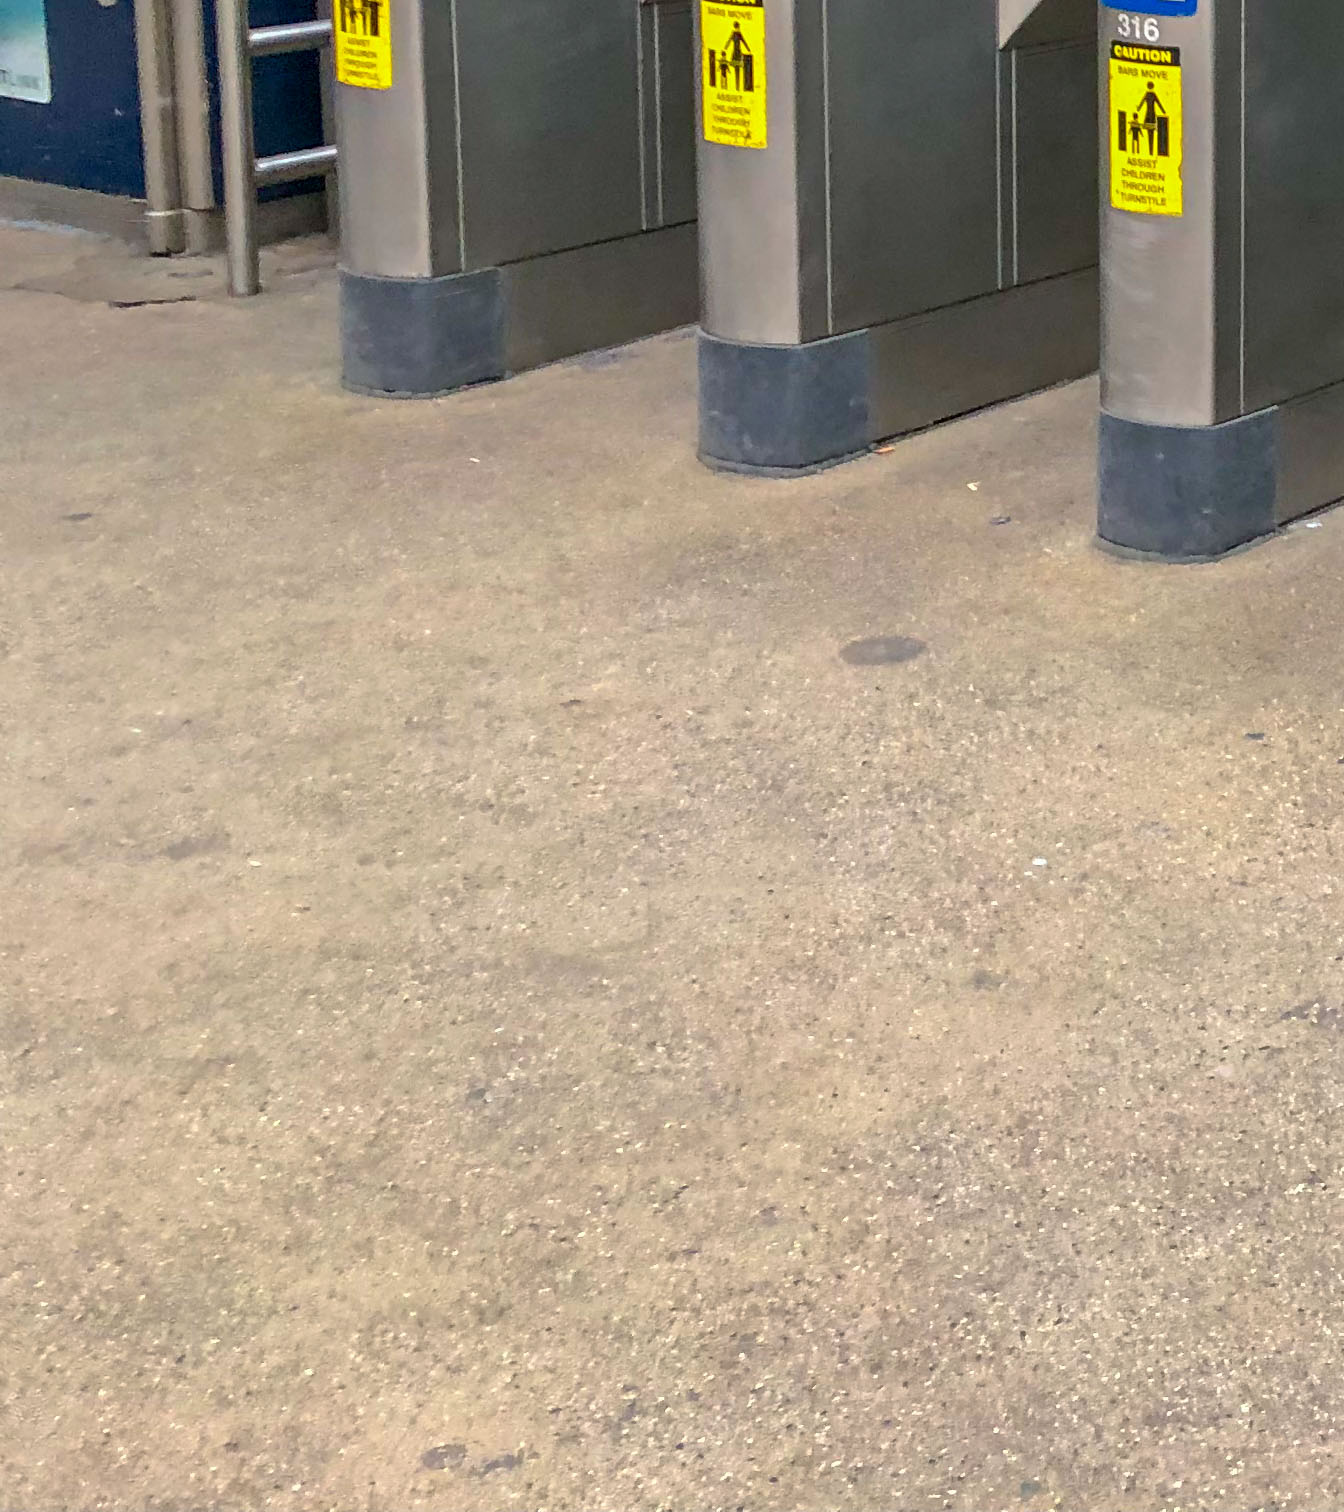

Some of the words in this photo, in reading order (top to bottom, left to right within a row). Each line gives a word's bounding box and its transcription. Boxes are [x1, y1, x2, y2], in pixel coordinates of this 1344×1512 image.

[1117, 13, 1160, 42] 316
[1113, 43, 1172, 64] CAUTION
[1117, 65, 1139, 78] BARS
[1140, 68, 1169, 81] MOVE
[1126, 157, 1158, 169] ASSIST
[1120, 167, 1165, 182] CHILDREN
[1121, 179, 1165, 194] THROUGH
[1119, 190, 1167, 207] TURNSTILE
